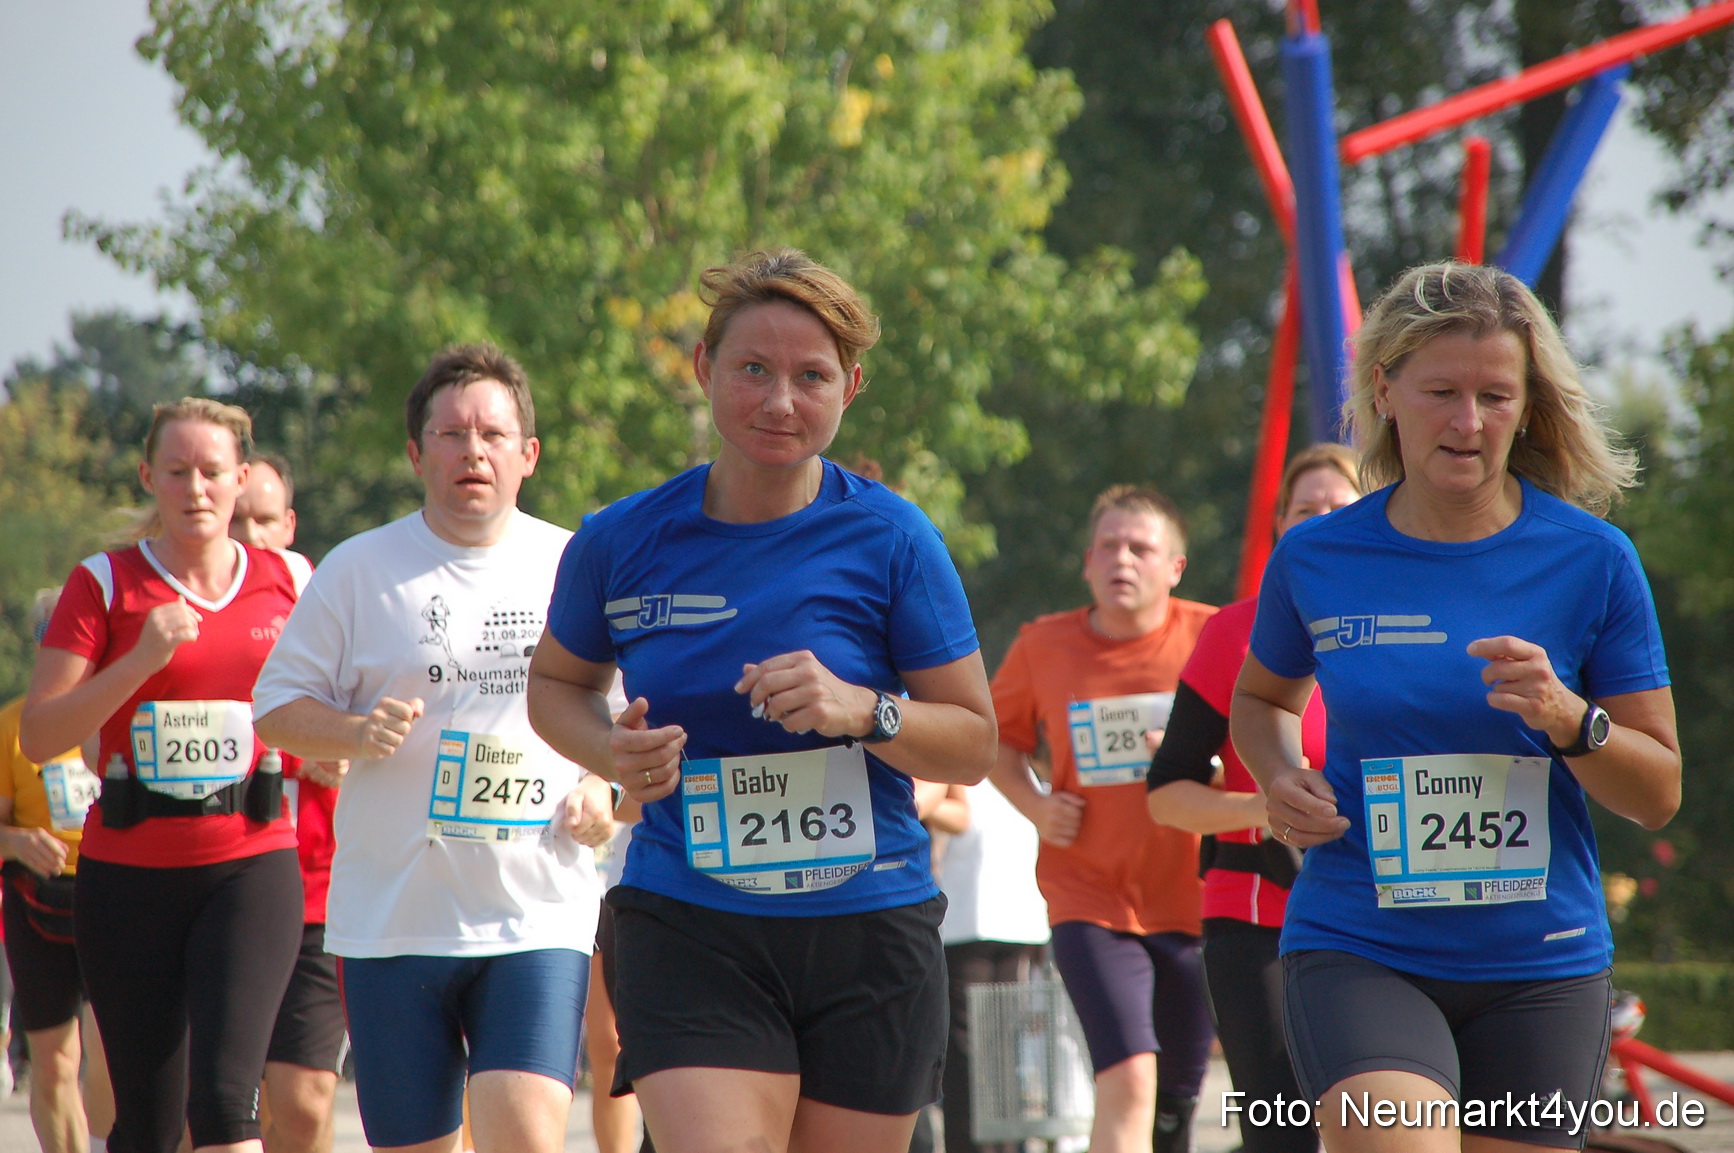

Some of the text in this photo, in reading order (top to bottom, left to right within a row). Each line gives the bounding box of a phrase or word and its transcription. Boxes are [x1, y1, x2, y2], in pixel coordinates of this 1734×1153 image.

[428, 665, 527, 683] 9. Neumark
[479, 681, 527, 695] Stadtl
[164, 711, 208, 728] Astrid
[166, 738, 239, 763] 2603
[475, 743, 523, 766] Dieter
[442, 770, 451, 785] D
[731, 766, 789, 797] Gaby
[1415, 769, 1483, 799] Conny
[472, 776, 546, 805] 2473
[693, 815, 705, 833] D
[739, 802, 857, 847] 2163
[1378, 814, 1389, 833] D
[1420, 810, 1530, 851] 2452
[1392, 886, 1437, 899] BOCK
[1484, 878, 1545, 893] PFLEIDERER
